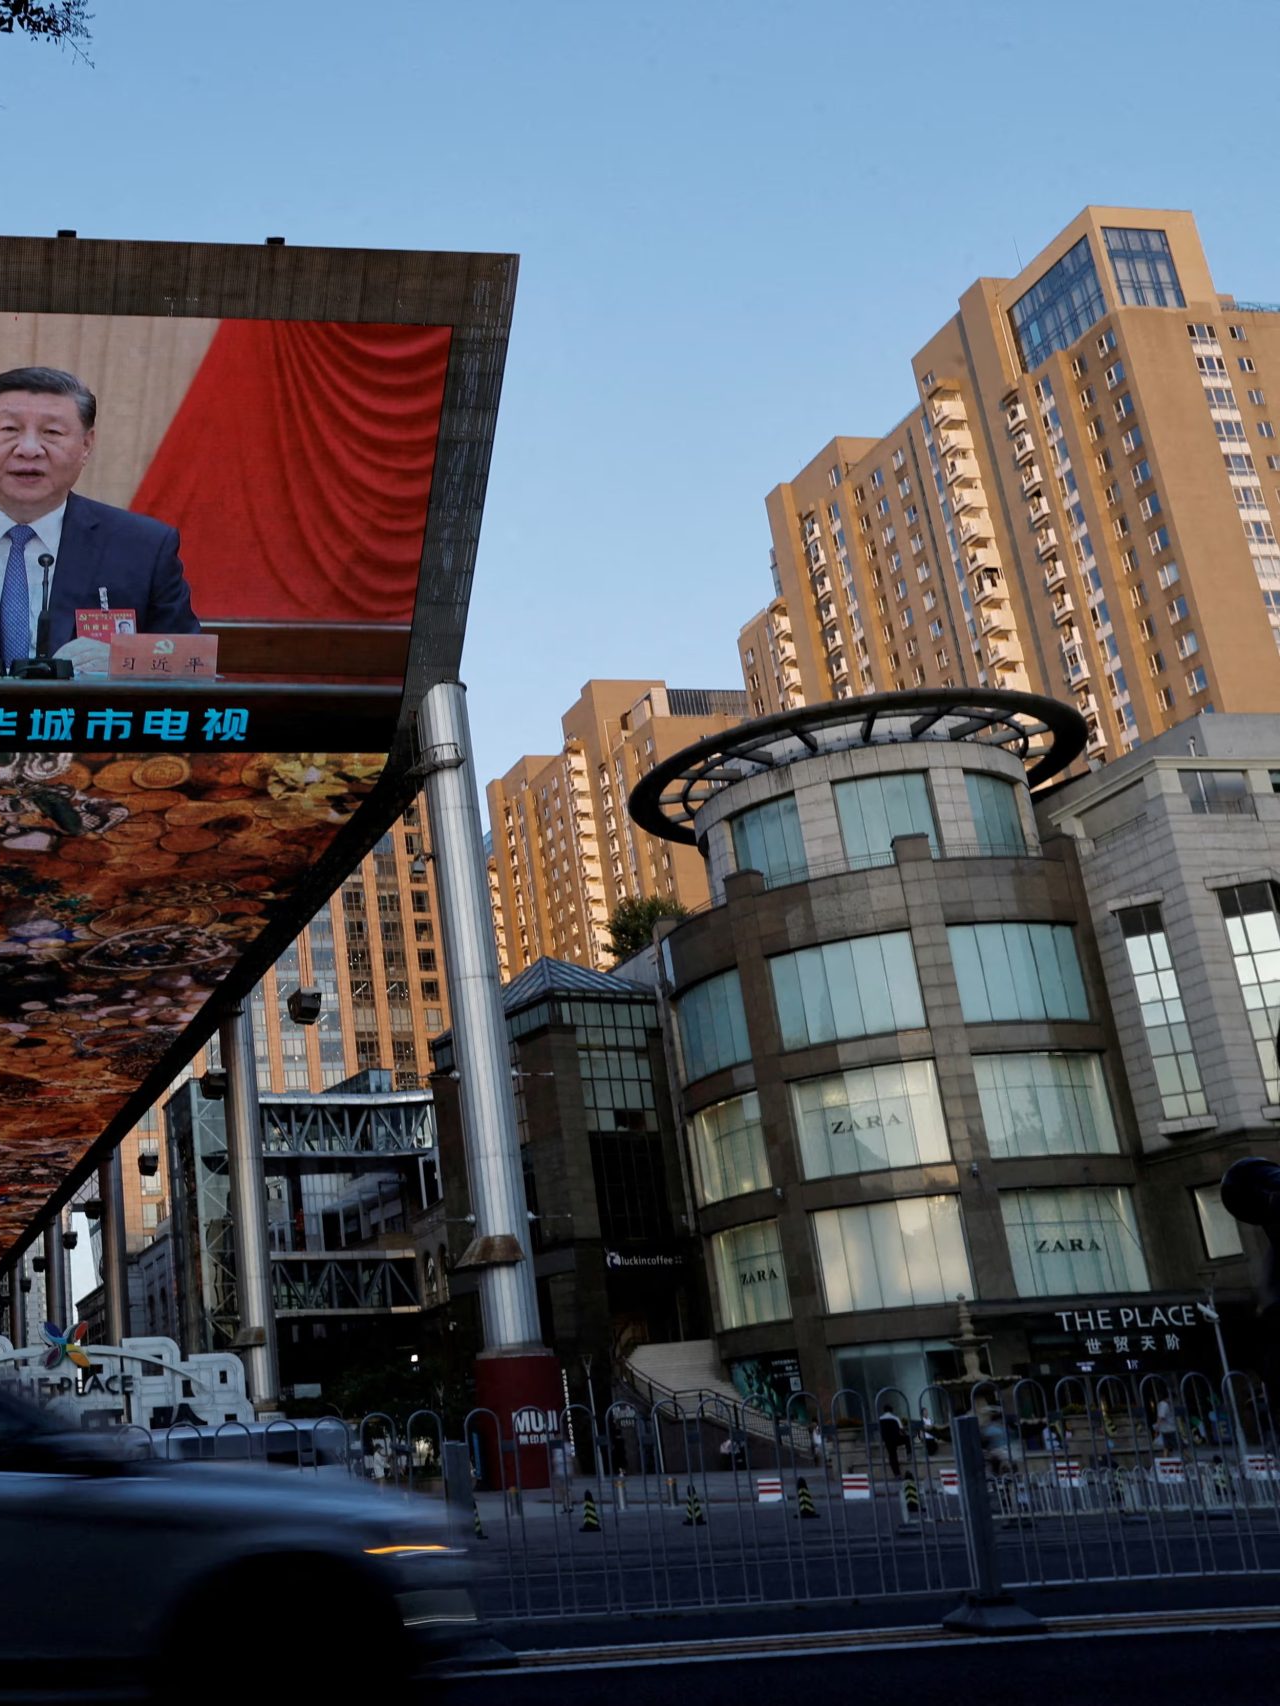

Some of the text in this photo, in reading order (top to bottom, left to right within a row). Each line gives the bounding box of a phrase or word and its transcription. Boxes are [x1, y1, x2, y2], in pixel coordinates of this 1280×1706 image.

[122, 656, 205, 673] 习近平
[831, 1113, 903, 1135] ZARA
[1034, 1238, 1101, 1253] ZARA
[740, 1268, 779, 1285] ZARA
[1055, 1305, 1196, 1332] THE PLACE
[1085, 1333, 1180, 1355] 世贸天阶
[60, 1374, 134, 1396] PLACE
[512, 1409, 559, 1433] MUJI
